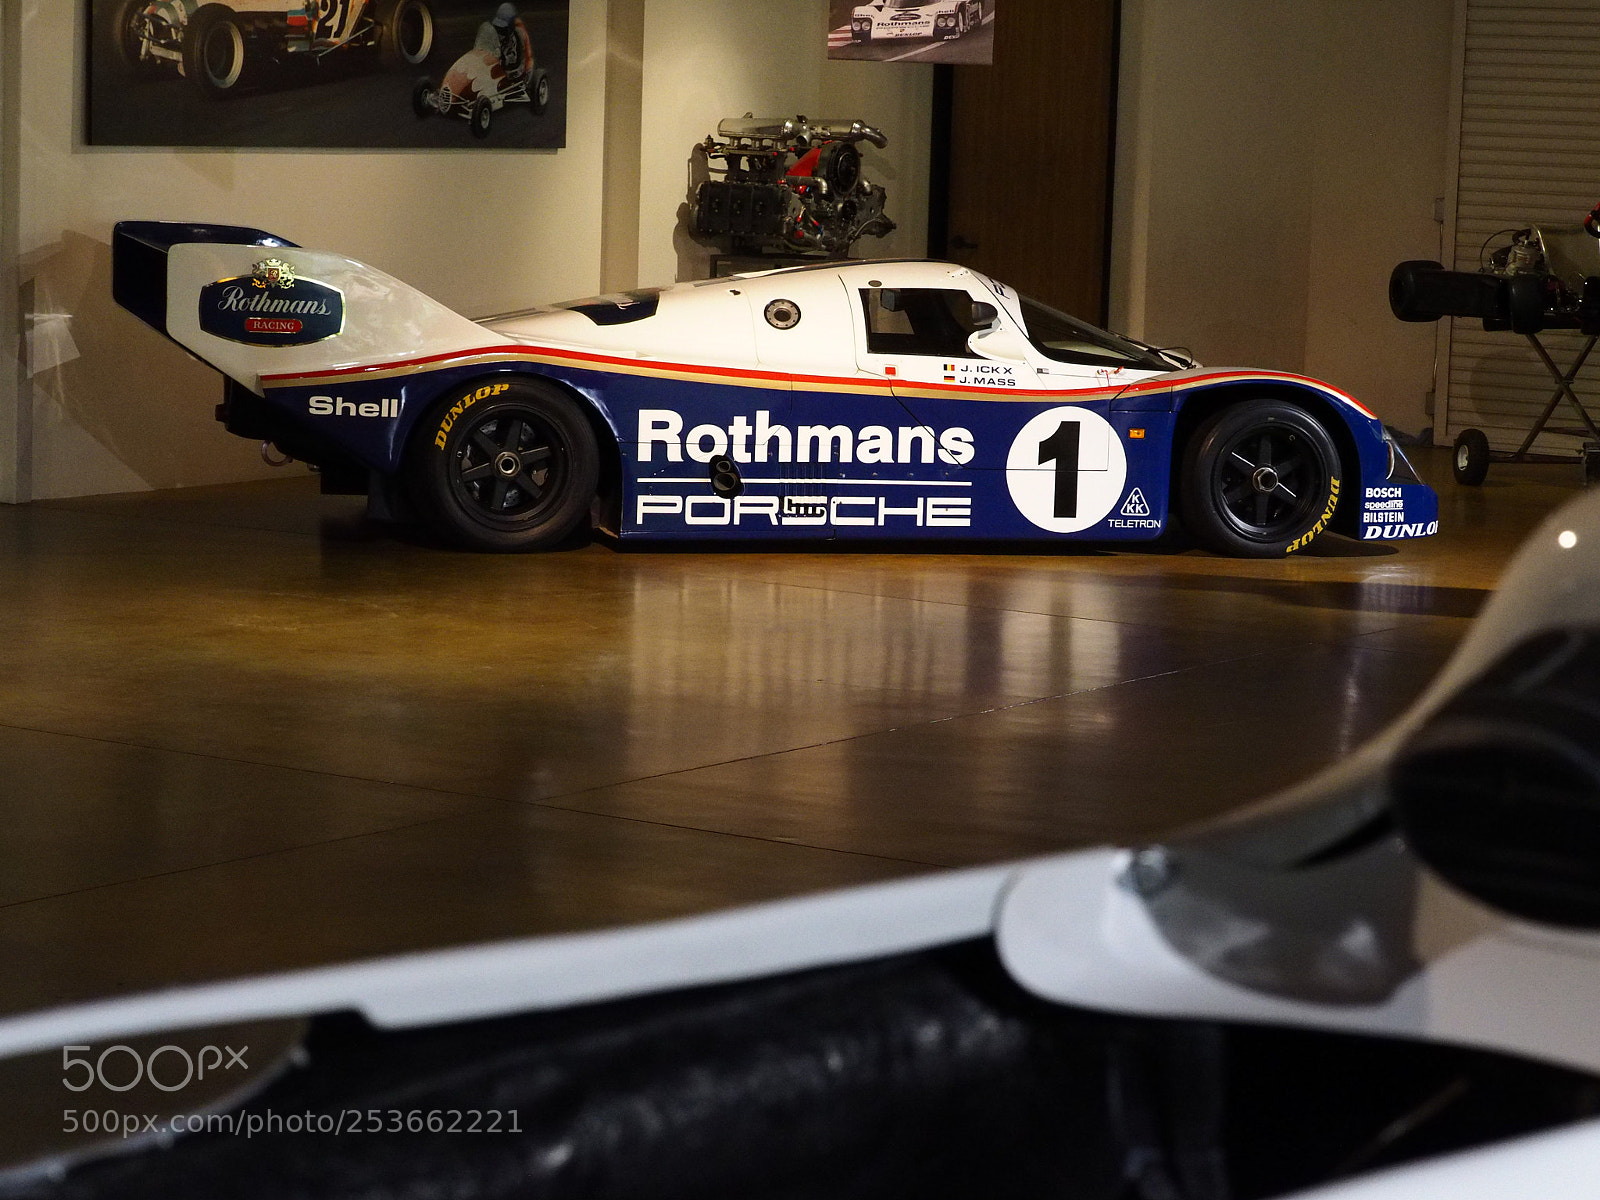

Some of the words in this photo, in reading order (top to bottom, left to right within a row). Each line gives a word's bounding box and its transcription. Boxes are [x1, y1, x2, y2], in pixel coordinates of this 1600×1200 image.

[316, 0, 349, 39] 21
[217, 285, 332, 316] Rothmans
[253, 320, 295, 331] RACING
[959, 376, 971, 385] J.
[974, 377, 1016, 387] MASS
[960, 364, 973, 373] J.
[308, 395, 398, 418] Shell
[434, 383, 509, 450] DUNLOP
[636, 408, 976, 465] Rothmans
[1037, 420, 1081, 518] 1
[1365, 487, 1402, 498] BOSCH
[636, 495, 972, 527] PORSCHE
[1107, 519, 1161, 529] TELETRON
[1286, 475, 1340, 553] DUNLOP
[1363, 511, 1405, 523] BILSTEIN
